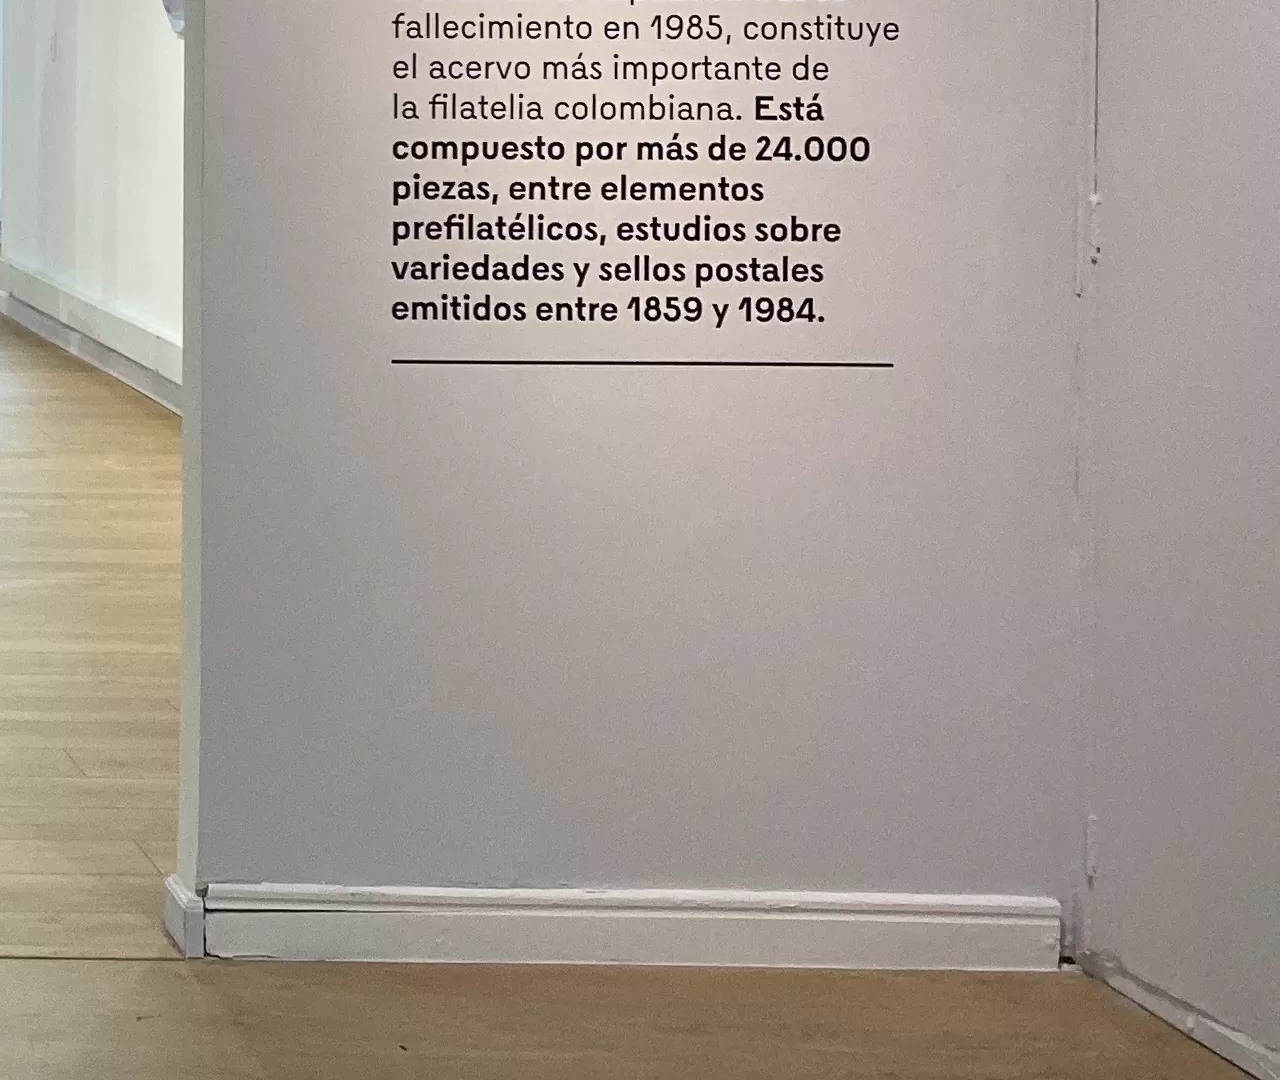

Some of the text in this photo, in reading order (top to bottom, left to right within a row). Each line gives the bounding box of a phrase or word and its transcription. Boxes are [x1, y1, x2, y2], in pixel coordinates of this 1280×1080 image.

[391, 11, 900, 48] fallecimiento en 1985, constituye
[392, 51, 830, 87] el acervo más importante de
[393, 92, 825, 122] la filatelia colombiana. Está
[392, 132, 871, 167] compuesto por más de 24.000
[392, 172, 765, 207] piezas, entre elementos
[392, 212, 842, 247] prefilatélicos, estudios sobre
[390, 253, 825, 289] variedades y sellos postales
[391, 293, 825, 329] emitidos entre 1859 y 1984.
